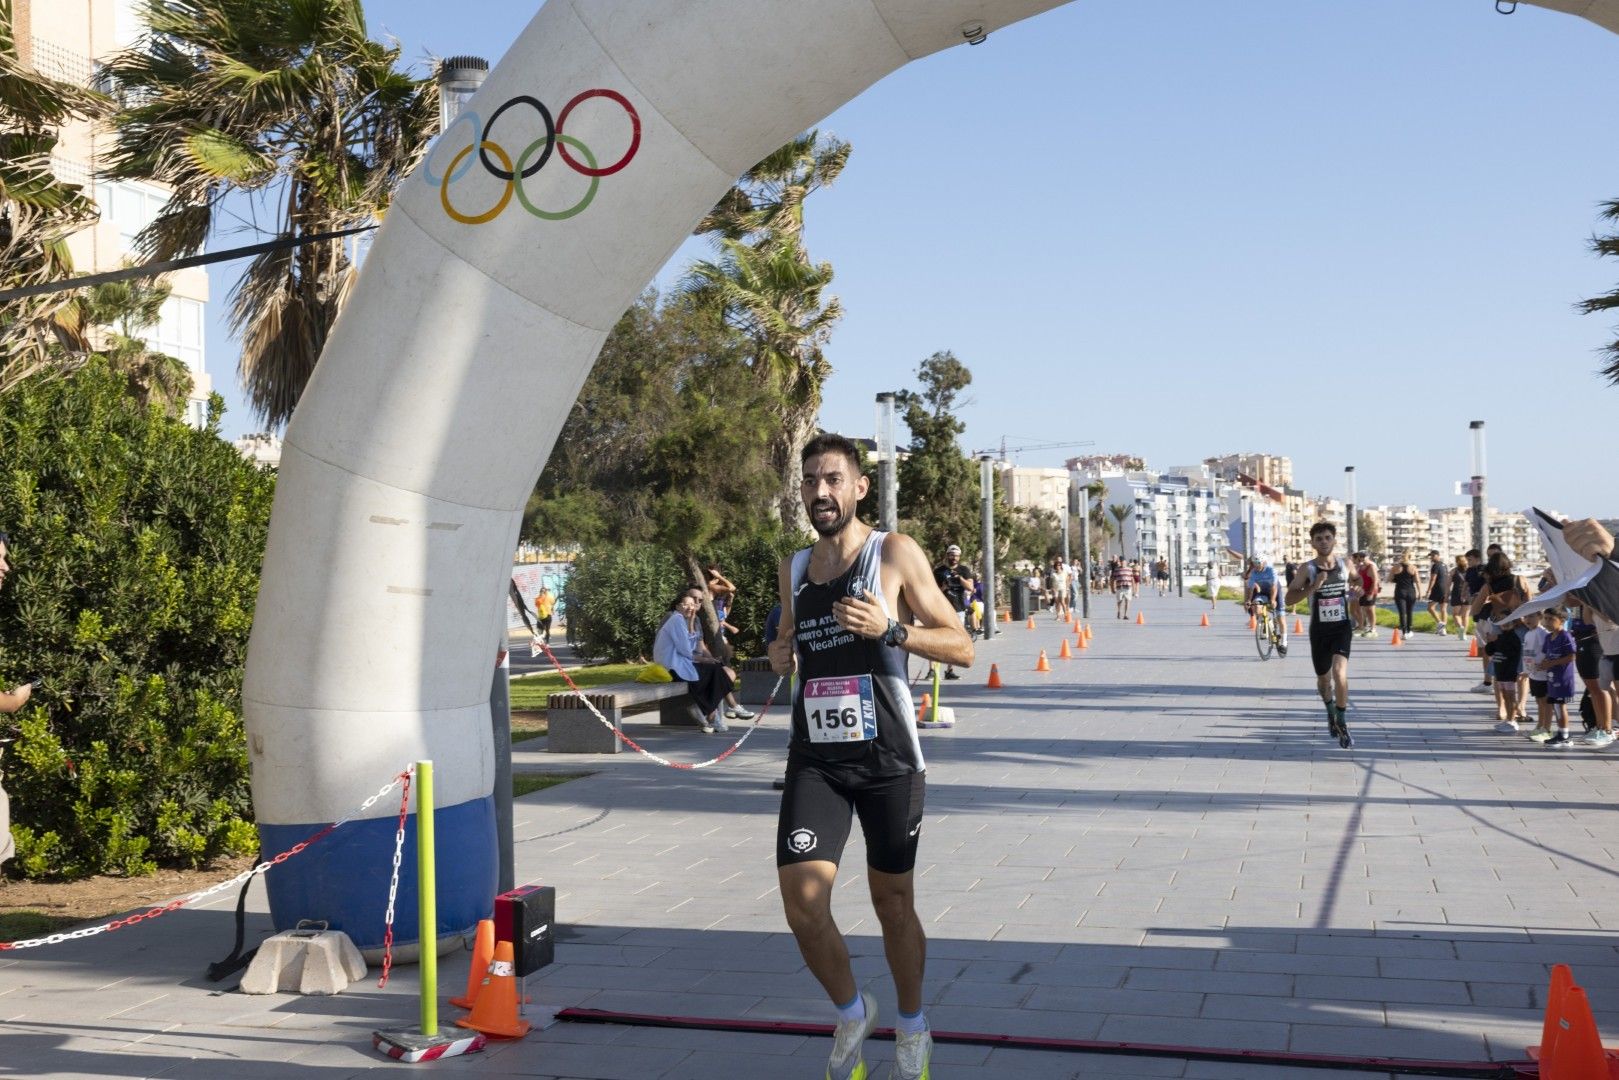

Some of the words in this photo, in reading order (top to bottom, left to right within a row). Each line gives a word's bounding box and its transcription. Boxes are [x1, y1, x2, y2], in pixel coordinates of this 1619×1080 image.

[799, 618, 817, 629] CLUB
[811, 707, 858, 730] 156
[862, 700, 874, 720] KM
